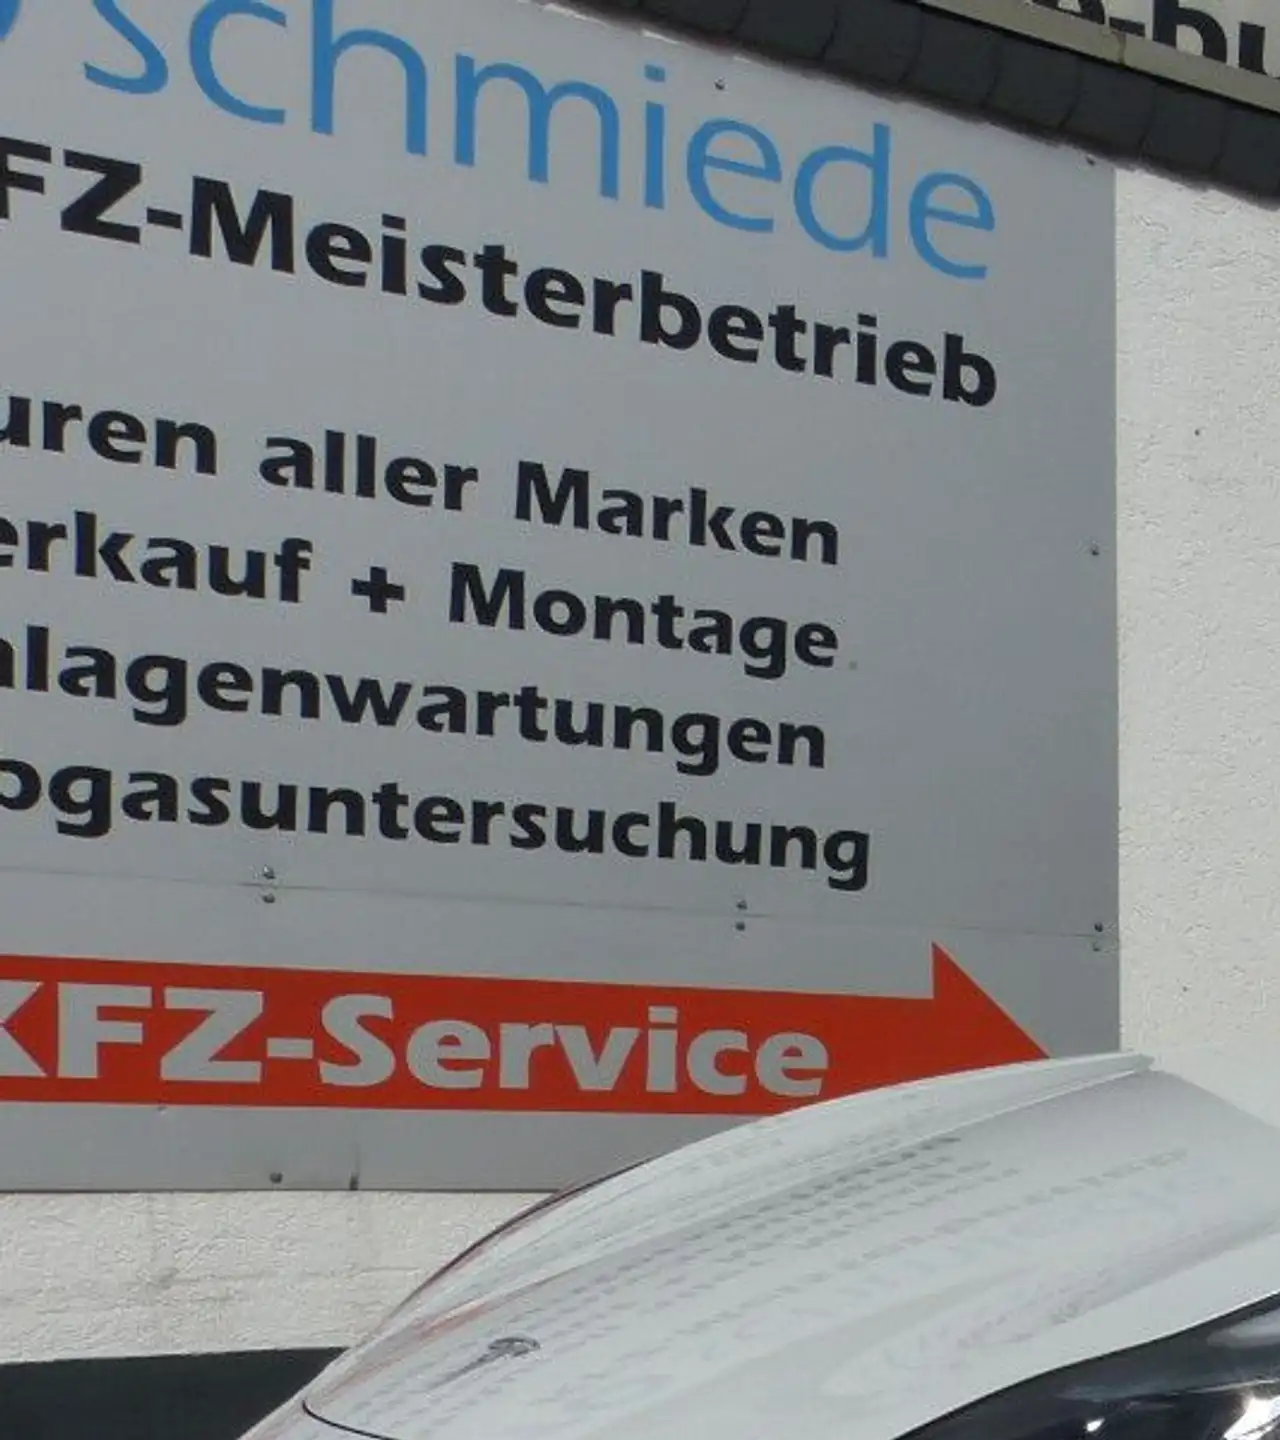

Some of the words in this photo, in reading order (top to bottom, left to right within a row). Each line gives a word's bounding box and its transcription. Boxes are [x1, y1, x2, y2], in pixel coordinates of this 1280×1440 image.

[259, 429, 479, 512] aller
[514, 460, 838, 566] Marken
[351, 566, 405, 614] +
[449, 561, 838, 680] Montage
[0, 625, 825, 777] lagenwartungen
